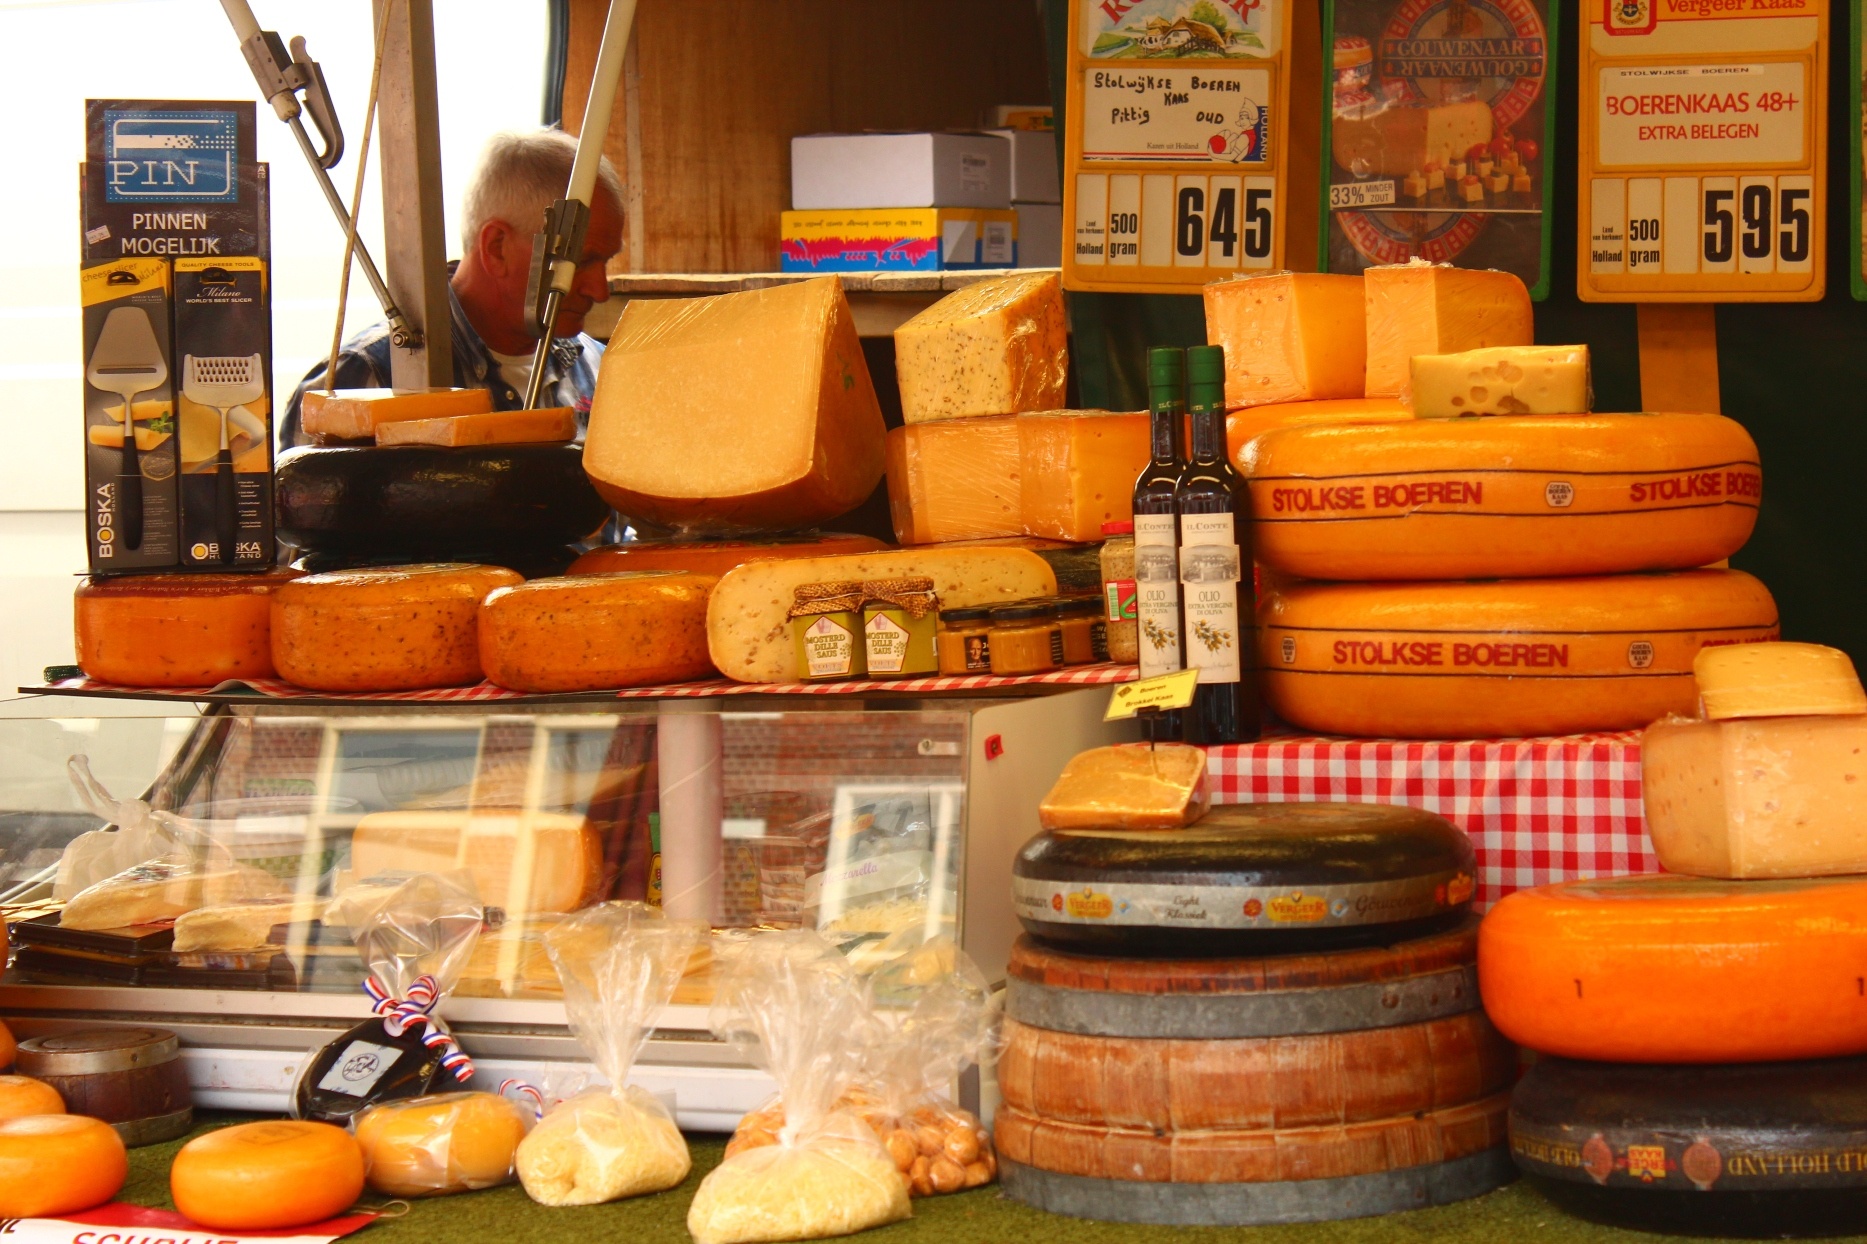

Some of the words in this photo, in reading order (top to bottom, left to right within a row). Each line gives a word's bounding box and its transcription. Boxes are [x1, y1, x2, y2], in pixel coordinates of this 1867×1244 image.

[1620, 69, 1690, 77] STOLWIJKSE
[1701, 67, 1749, 75] BOEREN
[1606, 93, 1749, 116] BOERENKAAS
[1756, 92, 1799, 112] 48+
[1260, 107, 1268, 160] HOLLAND
[1638, 125, 1687, 140] EXTRA
[1691, 123, 1759, 139] BELEGEN
[109, 160, 199, 185] PIN
[1330, 185, 1365, 206] 33%
[1365, 183, 1393, 194] MINDER
[1370, 193, 1389, 203] ZOUT
[132, 213, 207, 230] PINNEN
[1111, 213, 1138, 234] 500
[1177, 187, 1272, 258] 645
[1630, 219, 1660, 241] 500
[1704, 184, 1810, 263] 595
[121, 237, 220, 255] MOGELIJK
[1076, 242, 1103, 255] Holland
[1110, 241, 1137, 258] gram
[1592, 250, 1622, 263] Holland
[1630, 250, 1660, 267] gram
[82, 269, 112, 283] cheese
[113, 262, 138, 275] slicer
[200, 287, 241, 298] Milano
[1272, 486, 1366, 512] STOLKSE
[1374, 481, 1483, 508] BOEREN
[1629, 473, 1722, 503] STOLKSE
[96, 482, 115, 558] BOSKA
[1146, 590, 1166, 601] OLIO
[1198, 590, 1221, 602] OLIO
[806, 633, 846, 645] MOSTERD
[813, 643, 839, 652] DILLE
[871, 639, 893, 648] DILLE
[816, 650, 838, 659] SAUS
[873, 647, 892, 655] SAUS
[1332, 640, 1444, 666] STOLKSE
[1453, 642, 1568, 667] BOEREN
